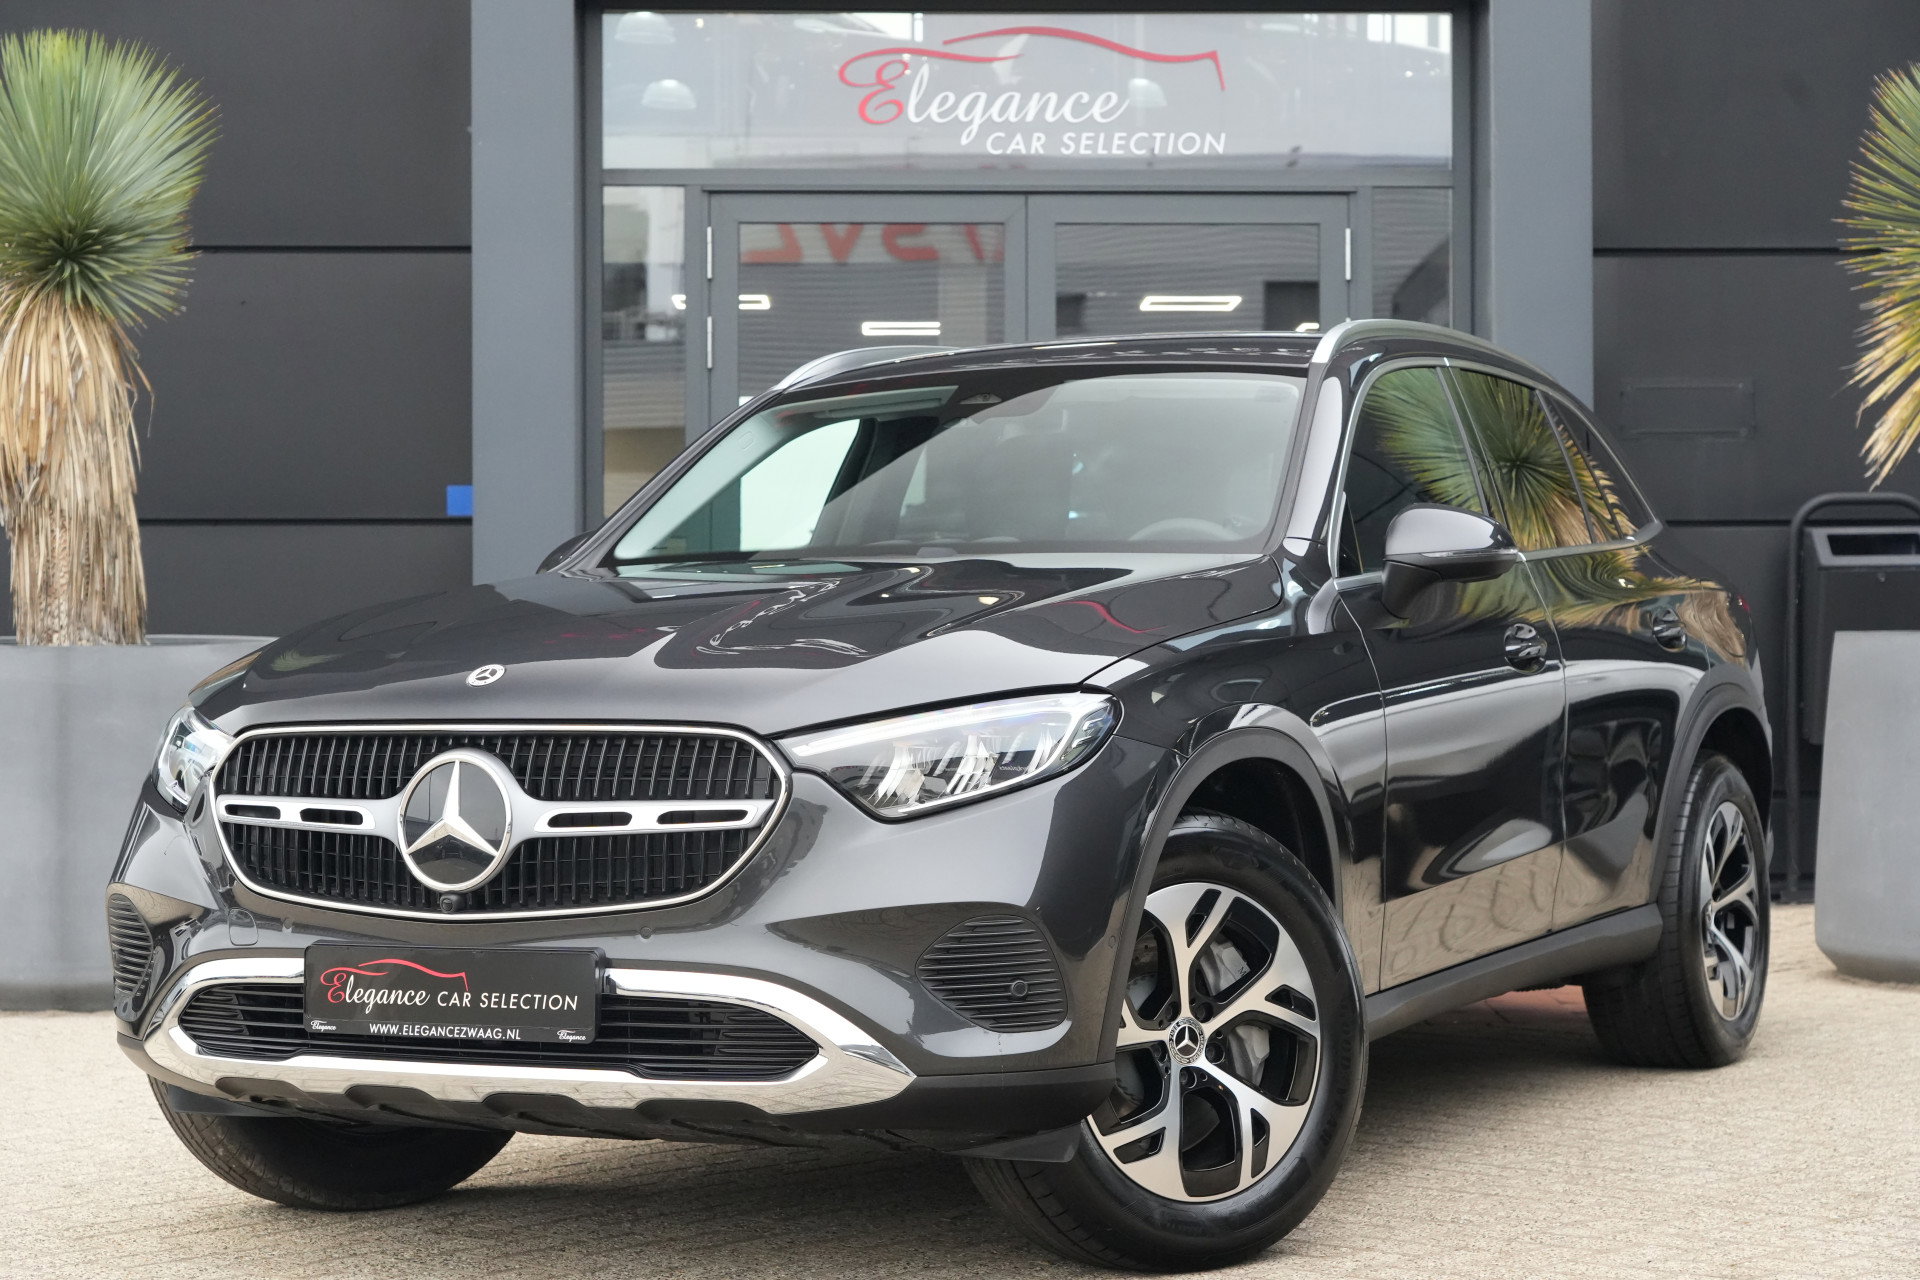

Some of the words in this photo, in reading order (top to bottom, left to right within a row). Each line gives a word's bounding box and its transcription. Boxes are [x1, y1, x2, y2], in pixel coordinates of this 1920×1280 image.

[838, 47, 1130, 146] Elegance
[985, 132, 1046, 155] CAR
[1060, 132, 1226, 155] SELECTION
[320, 967, 430, 1014] Elegance
[437, 991, 471, 1008] CAR
[479, 993, 578, 1011] SELECTION
[310, 1020, 337, 1032] Elegance
[369, 1023, 521, 1040] WWW.ELEGANCEZWAAG.NL
[557, 1030, 587, 1042] Elegance
